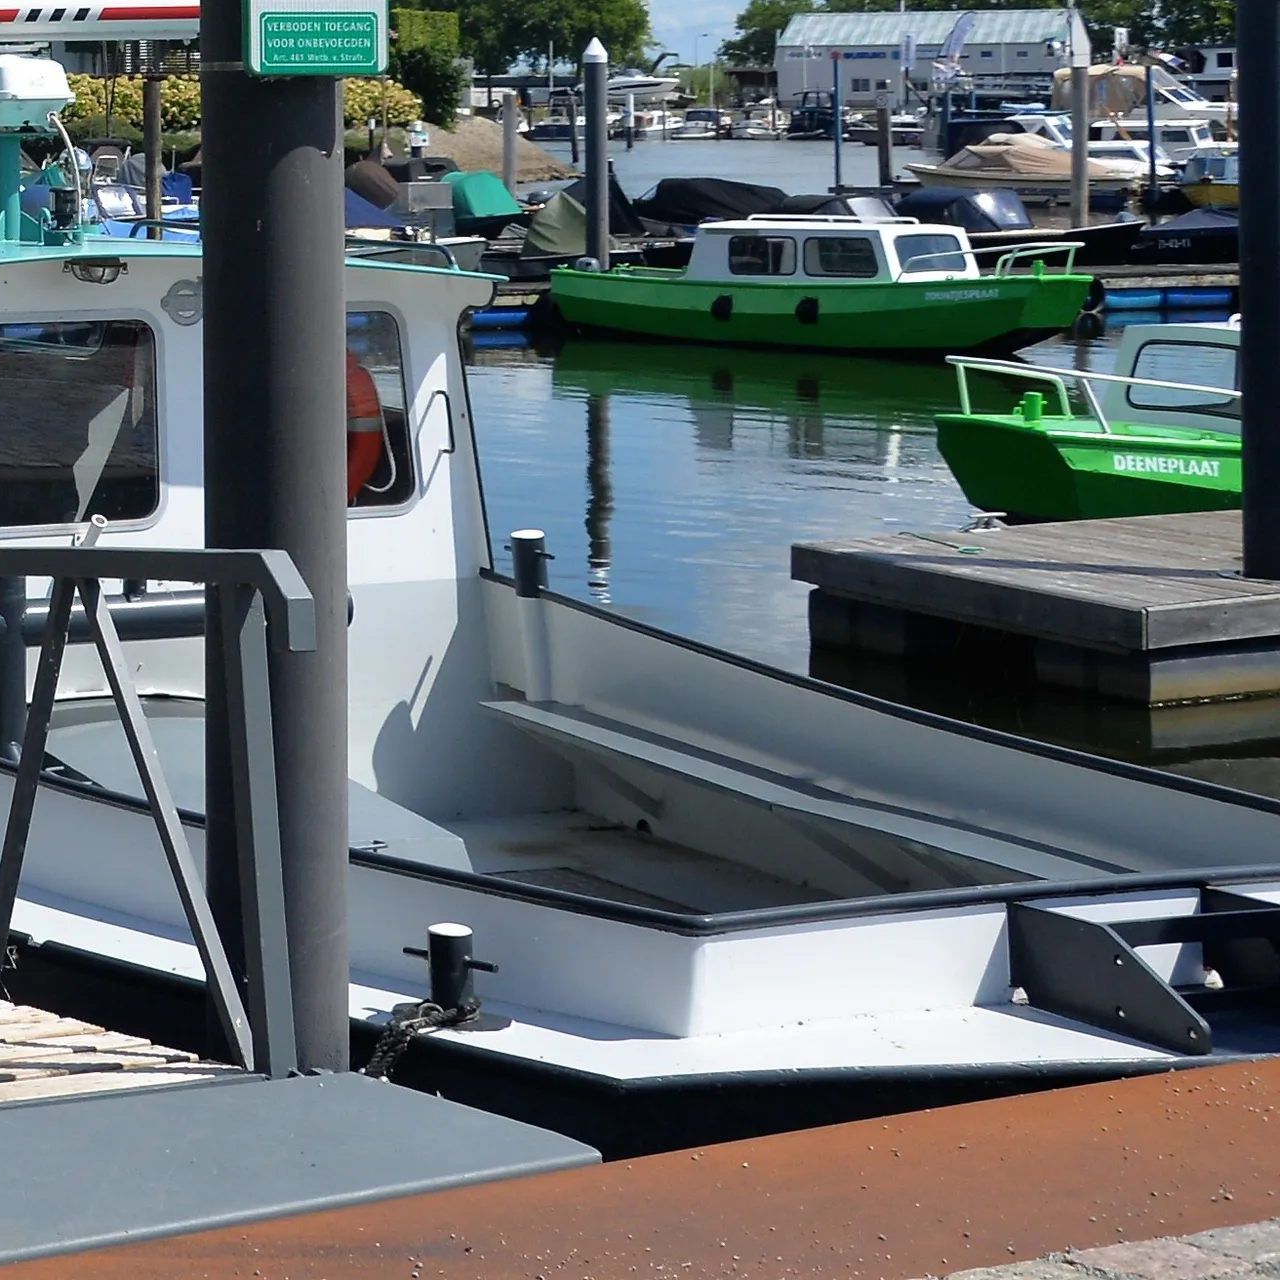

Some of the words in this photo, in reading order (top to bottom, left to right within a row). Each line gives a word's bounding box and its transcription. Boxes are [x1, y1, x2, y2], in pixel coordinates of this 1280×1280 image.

[267, 21, 321, 32] VERBODEN
[324, 22, 371, 32] TOEGANG
[267, 38, 295, 48] VOOR
[297, 38, 371, 48] ONBEVOEGDEN
[1113, 454, 1220, 477] DEENEPLAAT
